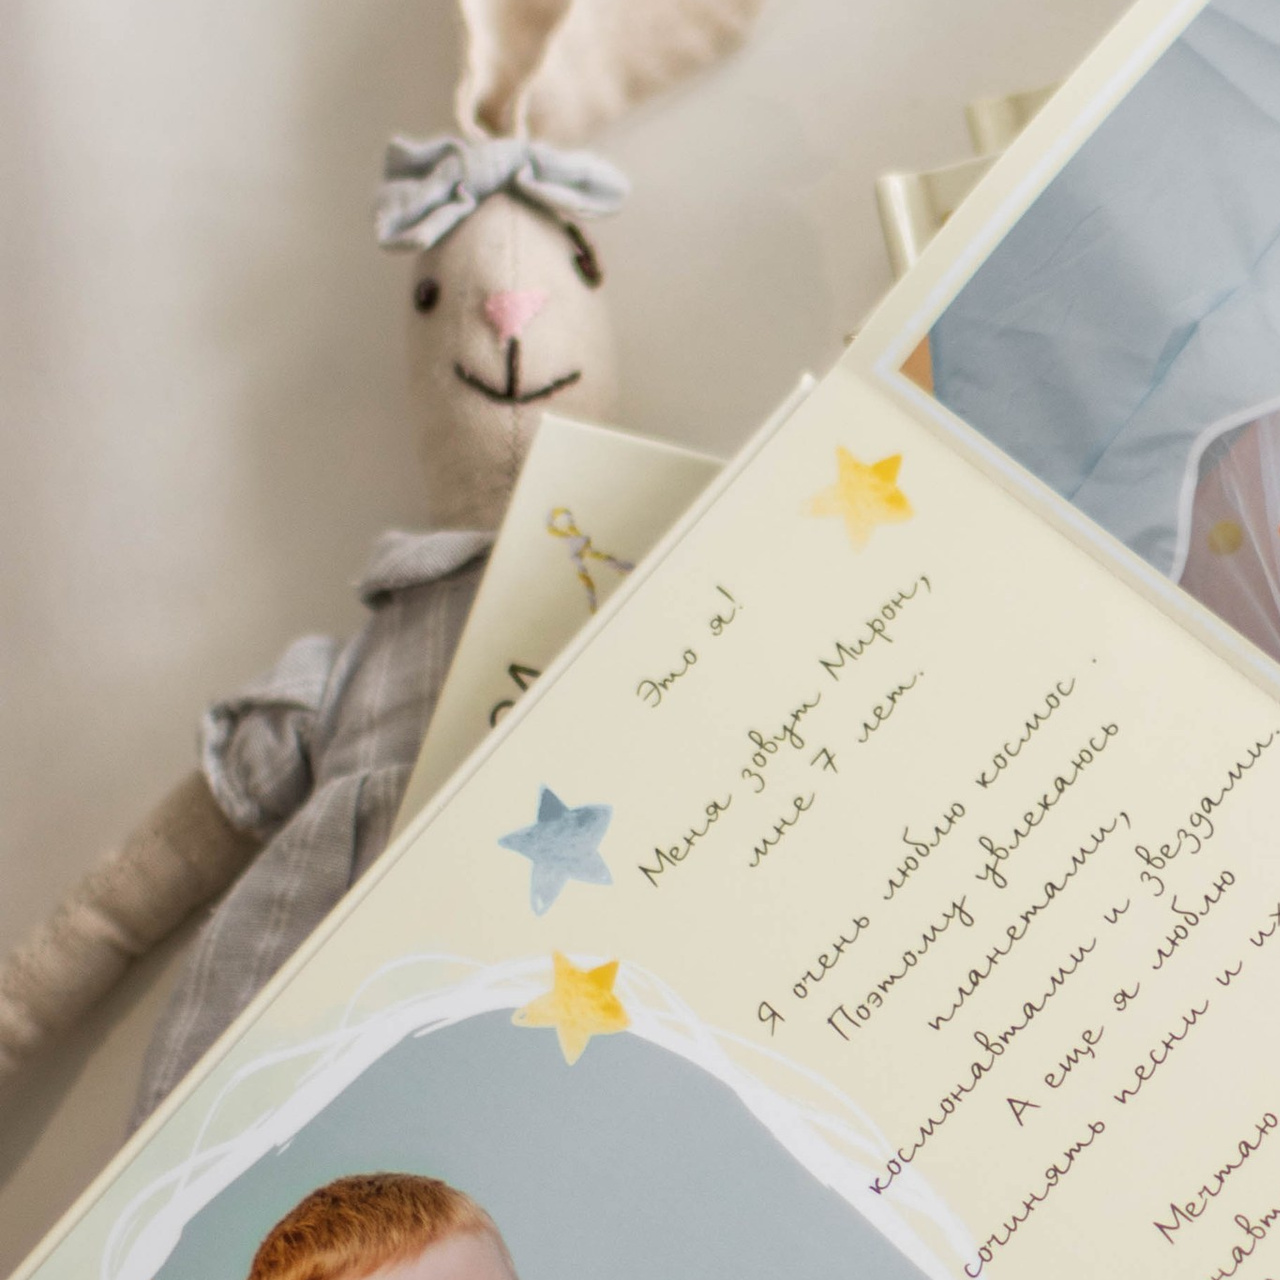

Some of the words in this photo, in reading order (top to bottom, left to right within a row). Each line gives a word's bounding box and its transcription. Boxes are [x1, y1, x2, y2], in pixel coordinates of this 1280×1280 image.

[637, 648, 698, 707] Это
[710, 585, 744, 636] я!
[639, 793, 731, 887] Меня
[742, 693, 821, 793] зовут
[820, 575, 932, 681] Мирон,
[750, 793, 815, 868] мне
[810, 749, 837, 774] 7
[858, 672, 924, 743] лет.
[828, 894, 974, 1041] Поэтому
[976, 722, 1119, 888] увлекаюсь
[758, 1002, 785, 1036] Я
[793, 915, 870, 1000] очень
[884, 802, 966, 900] люблю
[869, 938, 1096, 1195] космонавтами
[1104, 899, 1130, 924] и
[1134, 729, 1280, 897] звездами.
[929, 811, 1131, 1032] планетами,
[1007, 1096, 1040, 1126] А
[1045, 1025, 1104, 1089] еще
[1115, 982, 1140, 1012] я
[1152, 870, 1235, 970] люблю
[964, 1121, 1105, 1278] сочинять
[1114, 999, 1209, 1104] песни
[1217, 961, 1242, 987] и
[1153, 1113, 1277, 1245] Мечтаю
